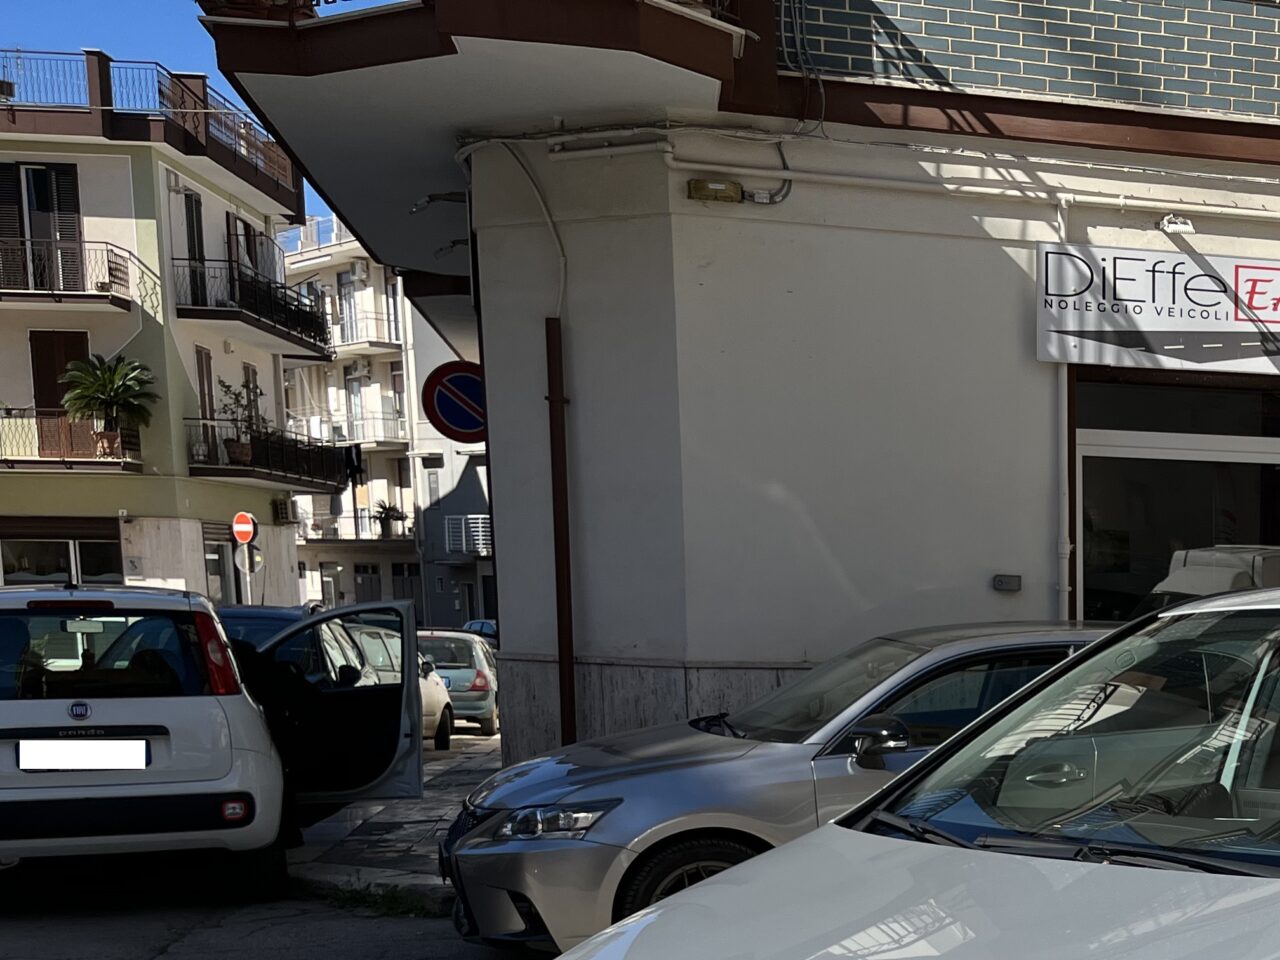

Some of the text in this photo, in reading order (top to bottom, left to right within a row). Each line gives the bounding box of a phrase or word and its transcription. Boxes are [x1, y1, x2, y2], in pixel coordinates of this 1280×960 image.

[1044, 250, 1228, 308] DiEffe
[1043, 298, 1230, 322] NOLEGGIO VEICOLI
